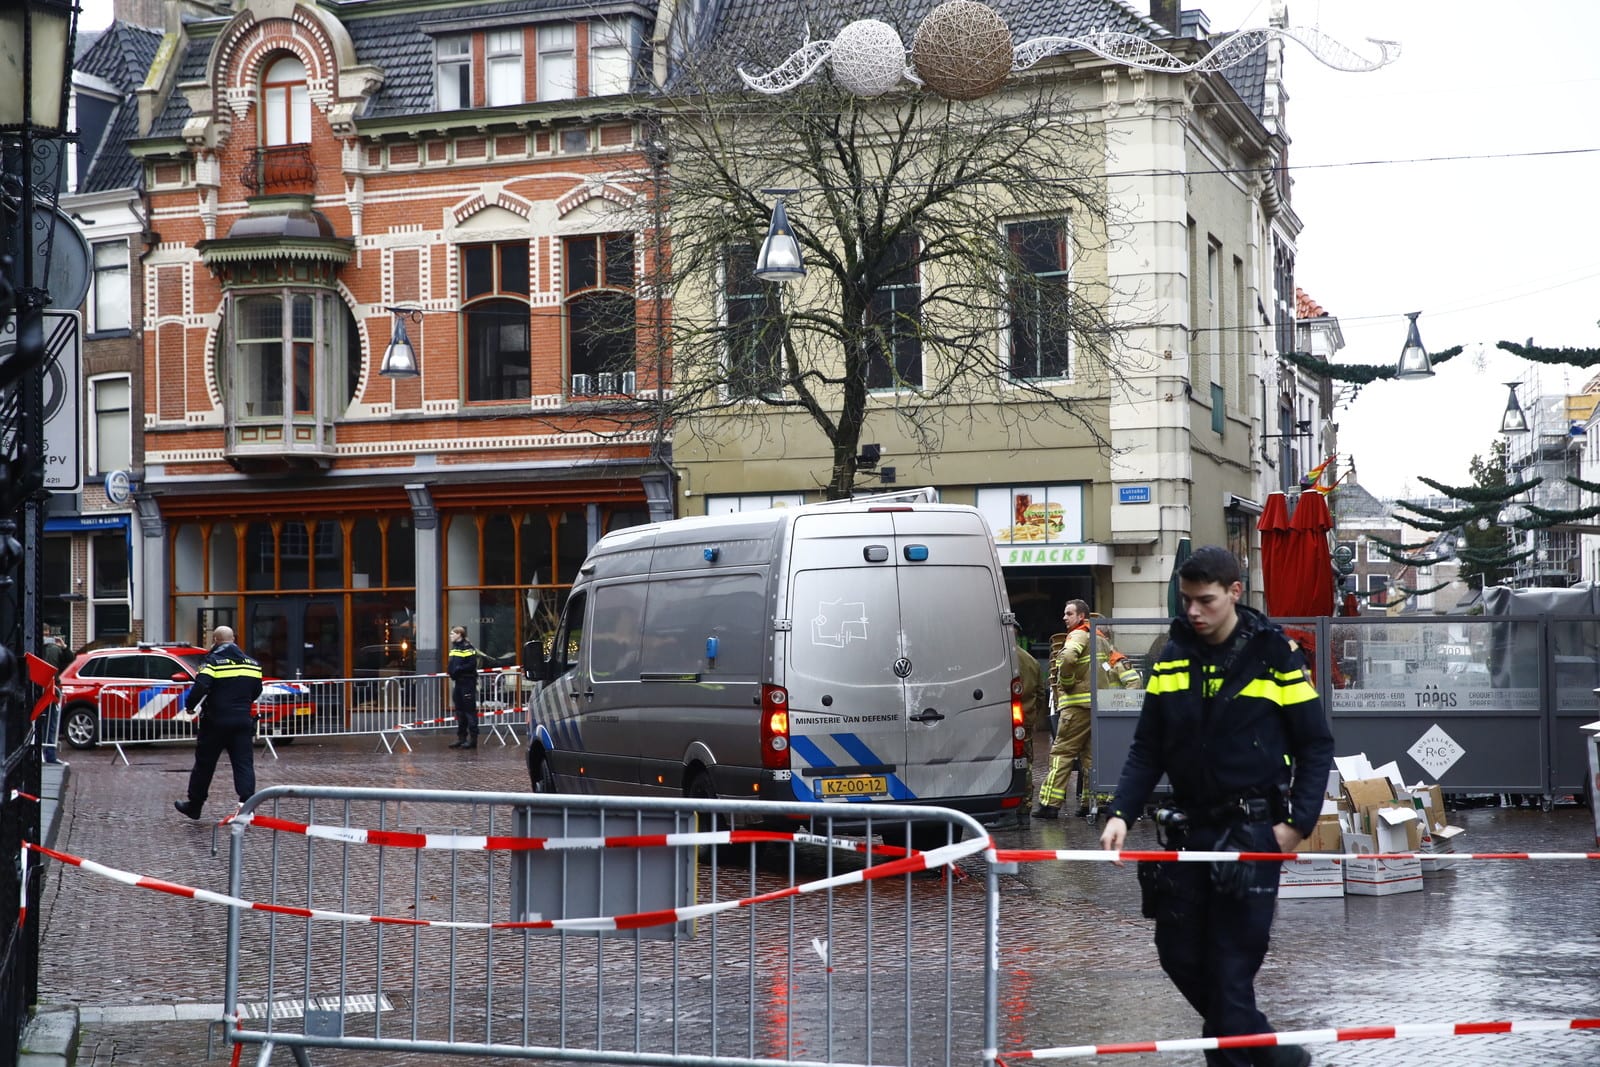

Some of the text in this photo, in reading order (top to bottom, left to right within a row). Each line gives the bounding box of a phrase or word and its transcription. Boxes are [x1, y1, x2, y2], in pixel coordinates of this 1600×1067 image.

[1009, 548, 1086, 563] SNACKS
[1415, 690, 1457, 707] TAPAS
[795, 714, 899, 725] MINISTERIE VAN DEFENSIE
[827, 780, 882, 792] KZ-00-12
